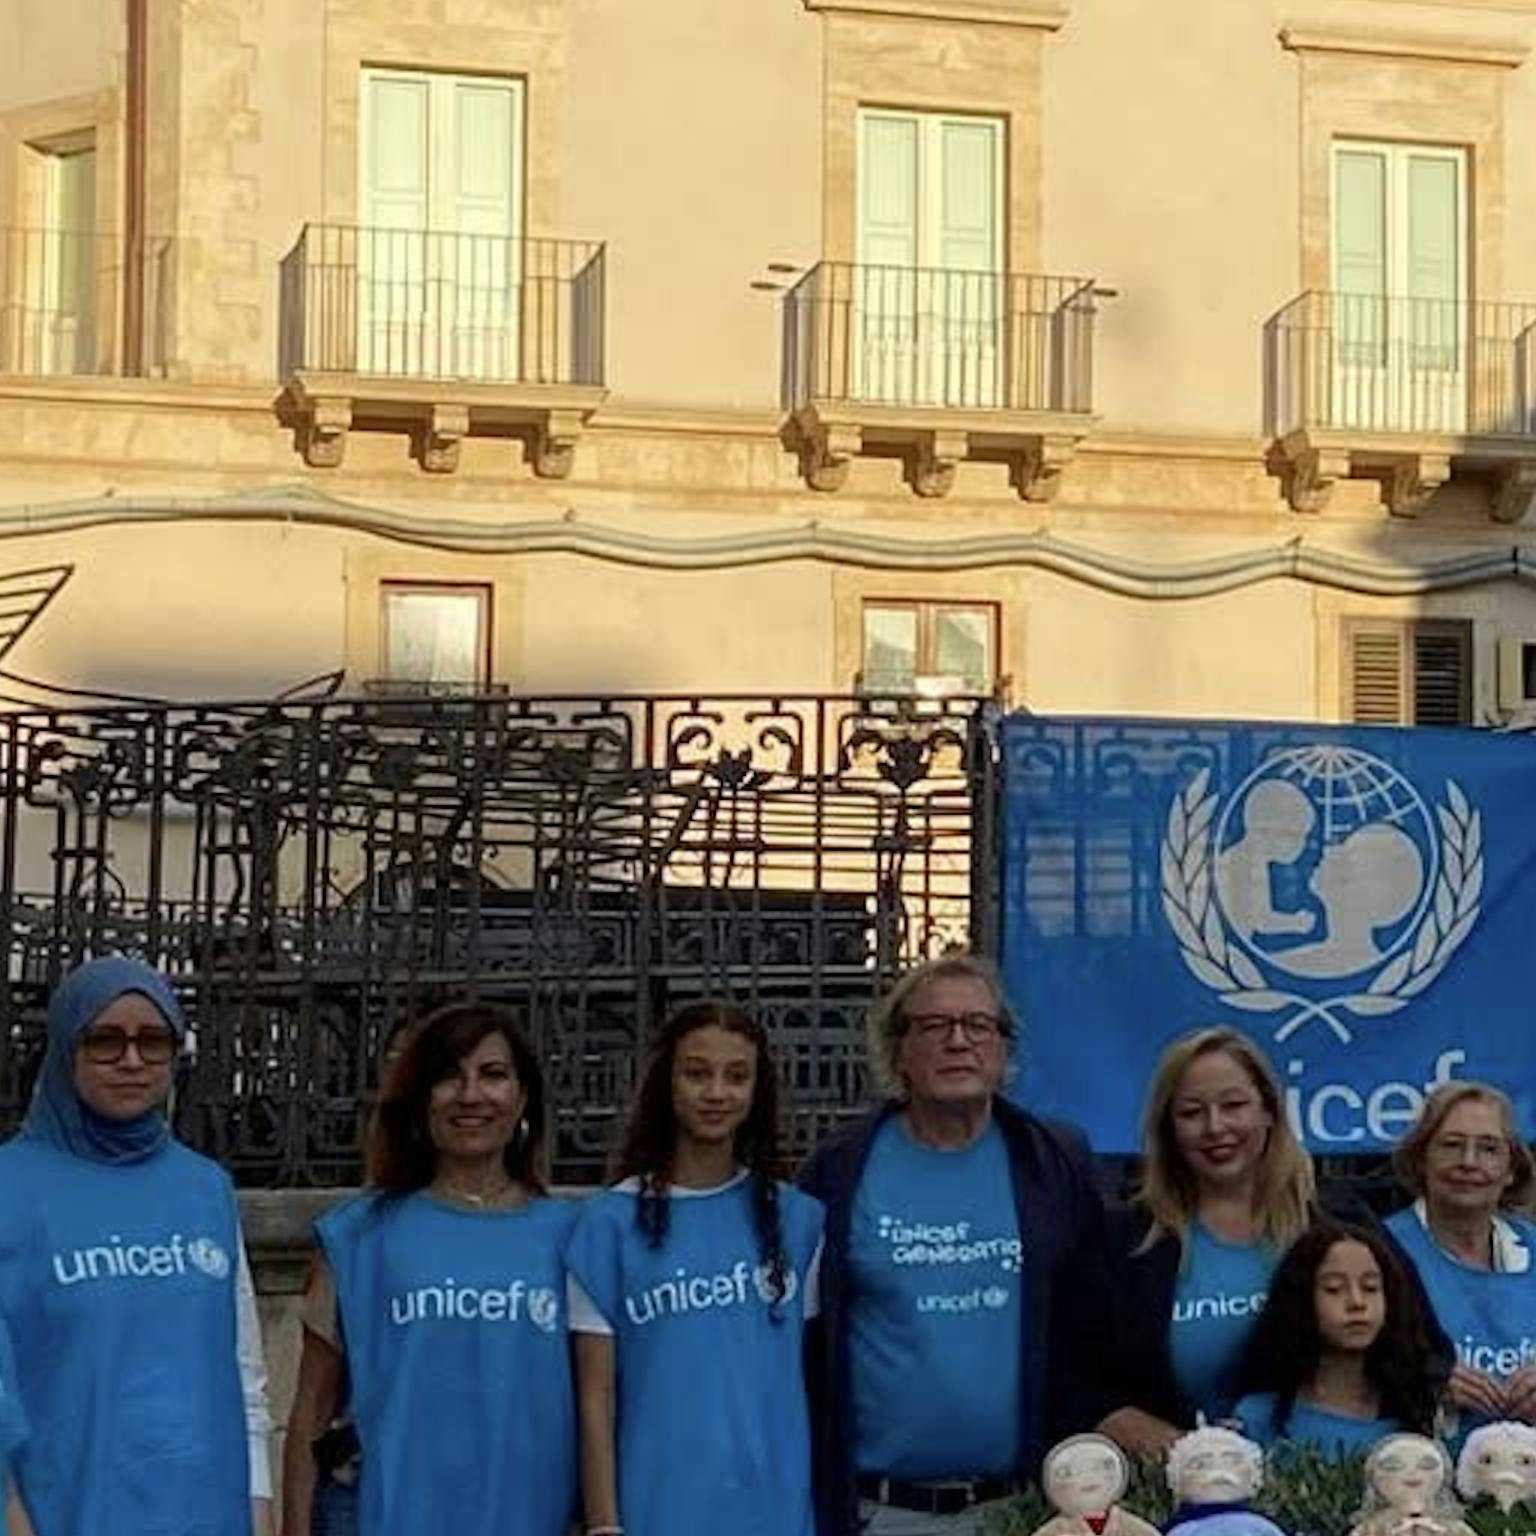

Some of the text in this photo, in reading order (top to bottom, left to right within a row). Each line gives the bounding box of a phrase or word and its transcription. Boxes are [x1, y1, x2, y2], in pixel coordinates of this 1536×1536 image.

[1285, 1049, 1466, 1142] icef
[54, 1235, 186, 1286] unicef
[390, 1279, 524, 1326] unicef
[626, 1267, 752, 1327] unicef
[916, 1288, 980, 1313] unicef
[1172, 1292, 1268, 1322] unice
[1460, 1337, 1531, 1376] icef
